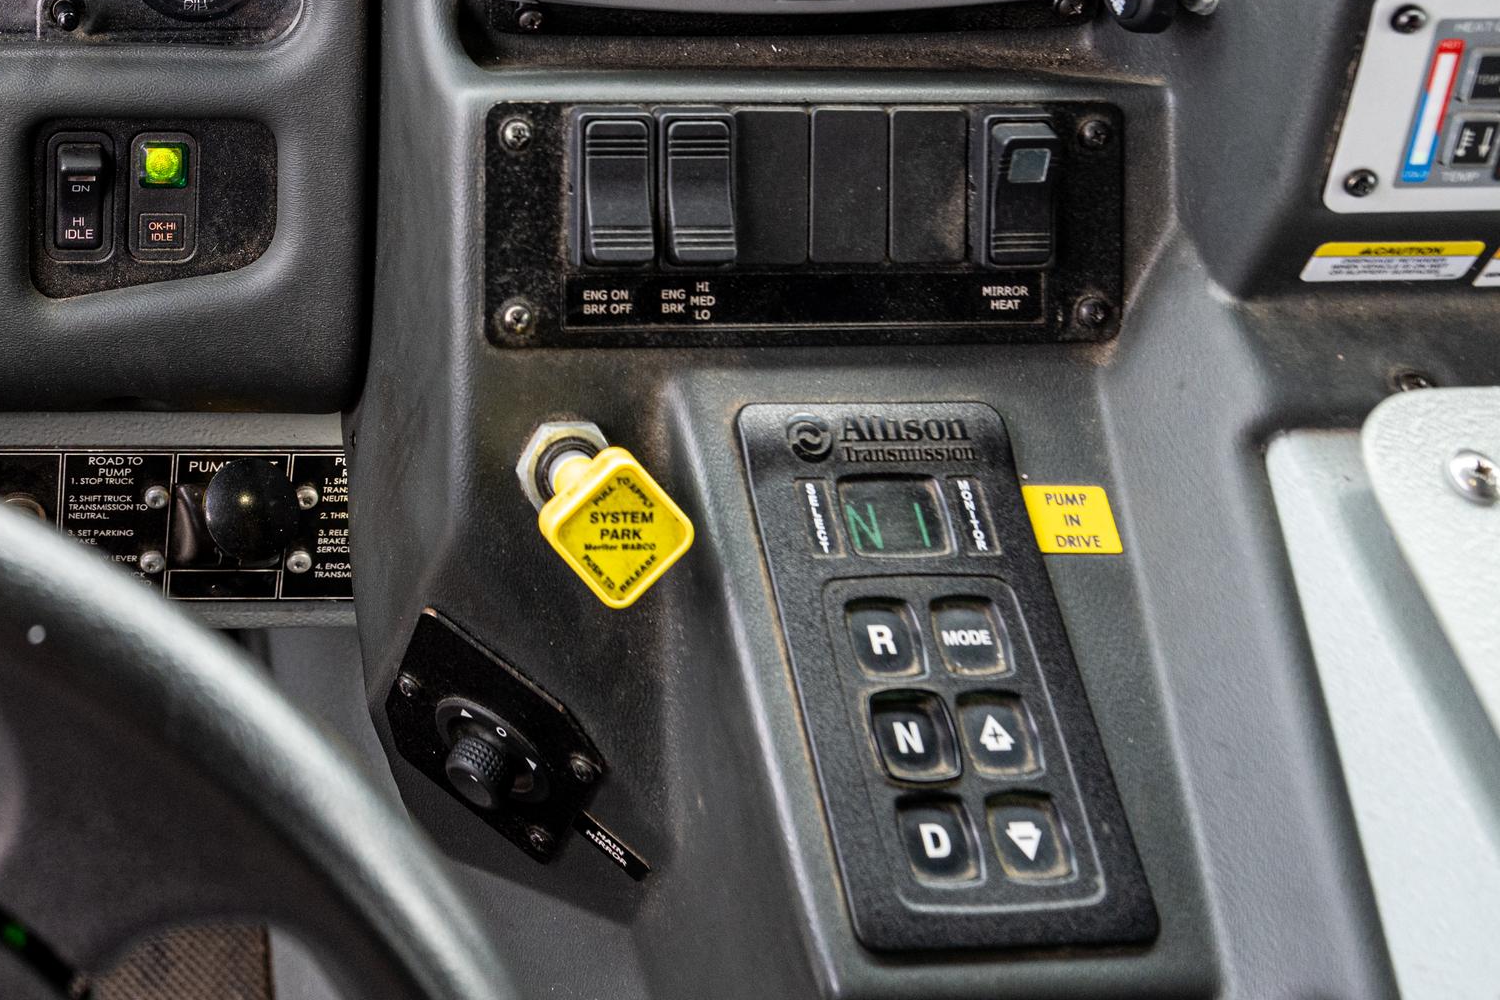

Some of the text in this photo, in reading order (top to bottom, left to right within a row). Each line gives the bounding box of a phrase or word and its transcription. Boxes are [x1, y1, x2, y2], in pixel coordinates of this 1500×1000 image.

[73, 217, 85, 226] HI
[65, 229, 93, 239] IDLE
[151, 233, 173, 241] IDLE
[583, 290, 628, 300] ENG ON
[661, 289, 686, 299] ENG
[982, 286, 1028, 296] MIRROR
[690, 296, 715, 306] MED
[990, 300, 1020, 310] HEAT
[584, 304, 633, 314] BRK OFF
[662, 303, 685, 313] BRK
[695, 310, 710, 320] LO
[840, 416, 972, 441] Allison
[842, 447, 978, 462] Transmission
[89, 457, 143, 465] ROAD TO
[99, 468, 131, 476] PUMP
[1045, 493, 1087, 505] PUMP
[590, 512, 654, 523] SYSTEM
[805, 483, 829, 553] SELECT
[957, 480, 988, 551] MONITOR
[600, 529, 641, 540] PARK
[1056, 535, 1102, 548] DRIVE
[583, 554, 604, 577] PUSH
[620, 555, 656, 592] RELEASE
[867, 625, 898, 655] R
[942, 630, 992, 646] MODE
[893, 722, 925, 753] N
[597, 831, 624, 855] MAIN
[919, 824, 951, 858] D
[586, 830, 627, 867] MIRROR
